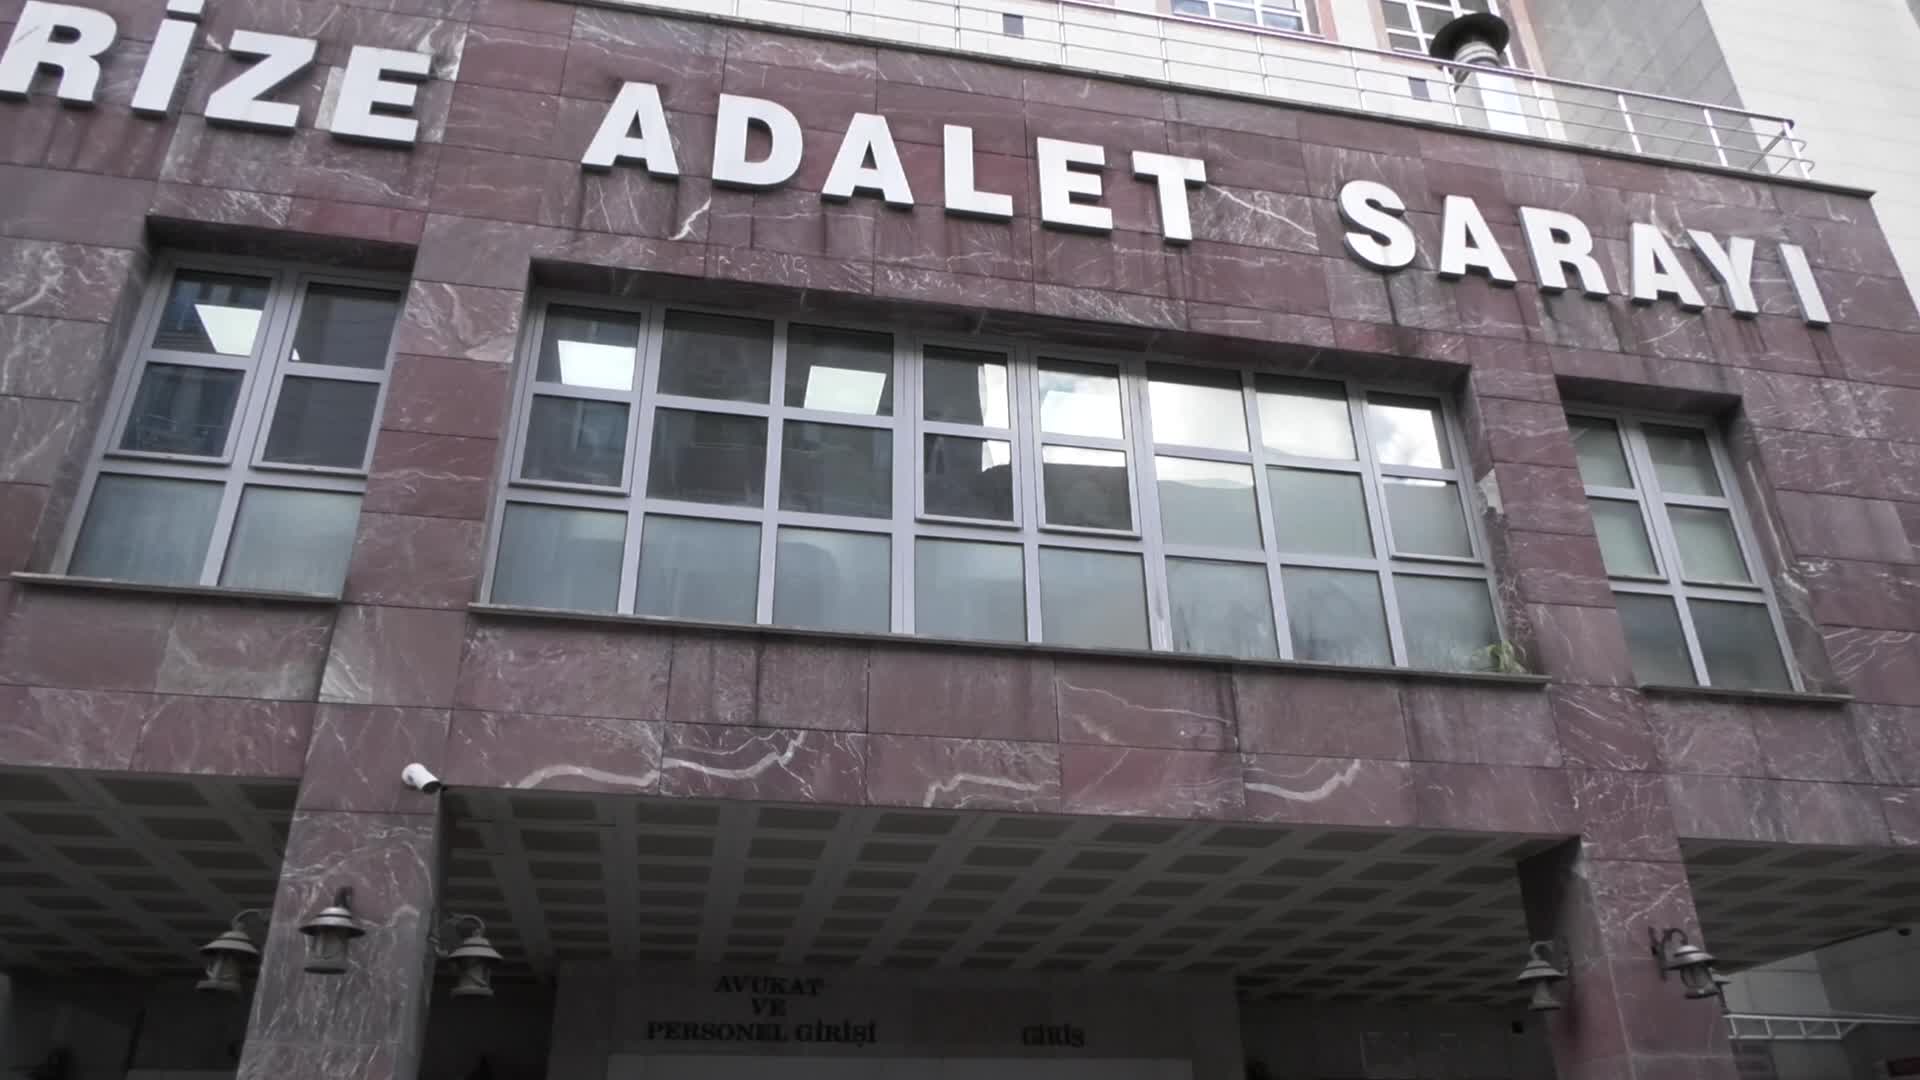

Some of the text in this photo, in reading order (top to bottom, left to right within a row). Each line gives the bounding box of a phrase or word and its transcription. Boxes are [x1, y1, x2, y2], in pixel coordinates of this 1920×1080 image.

[0, 0, 1830, 326] RİZE ADALET SARAYI
[714, 975, 825, 997] AVUKAT
[750, 996, 787, 1017] VE
[647, 1021, 789, 1041] PERSONEL
